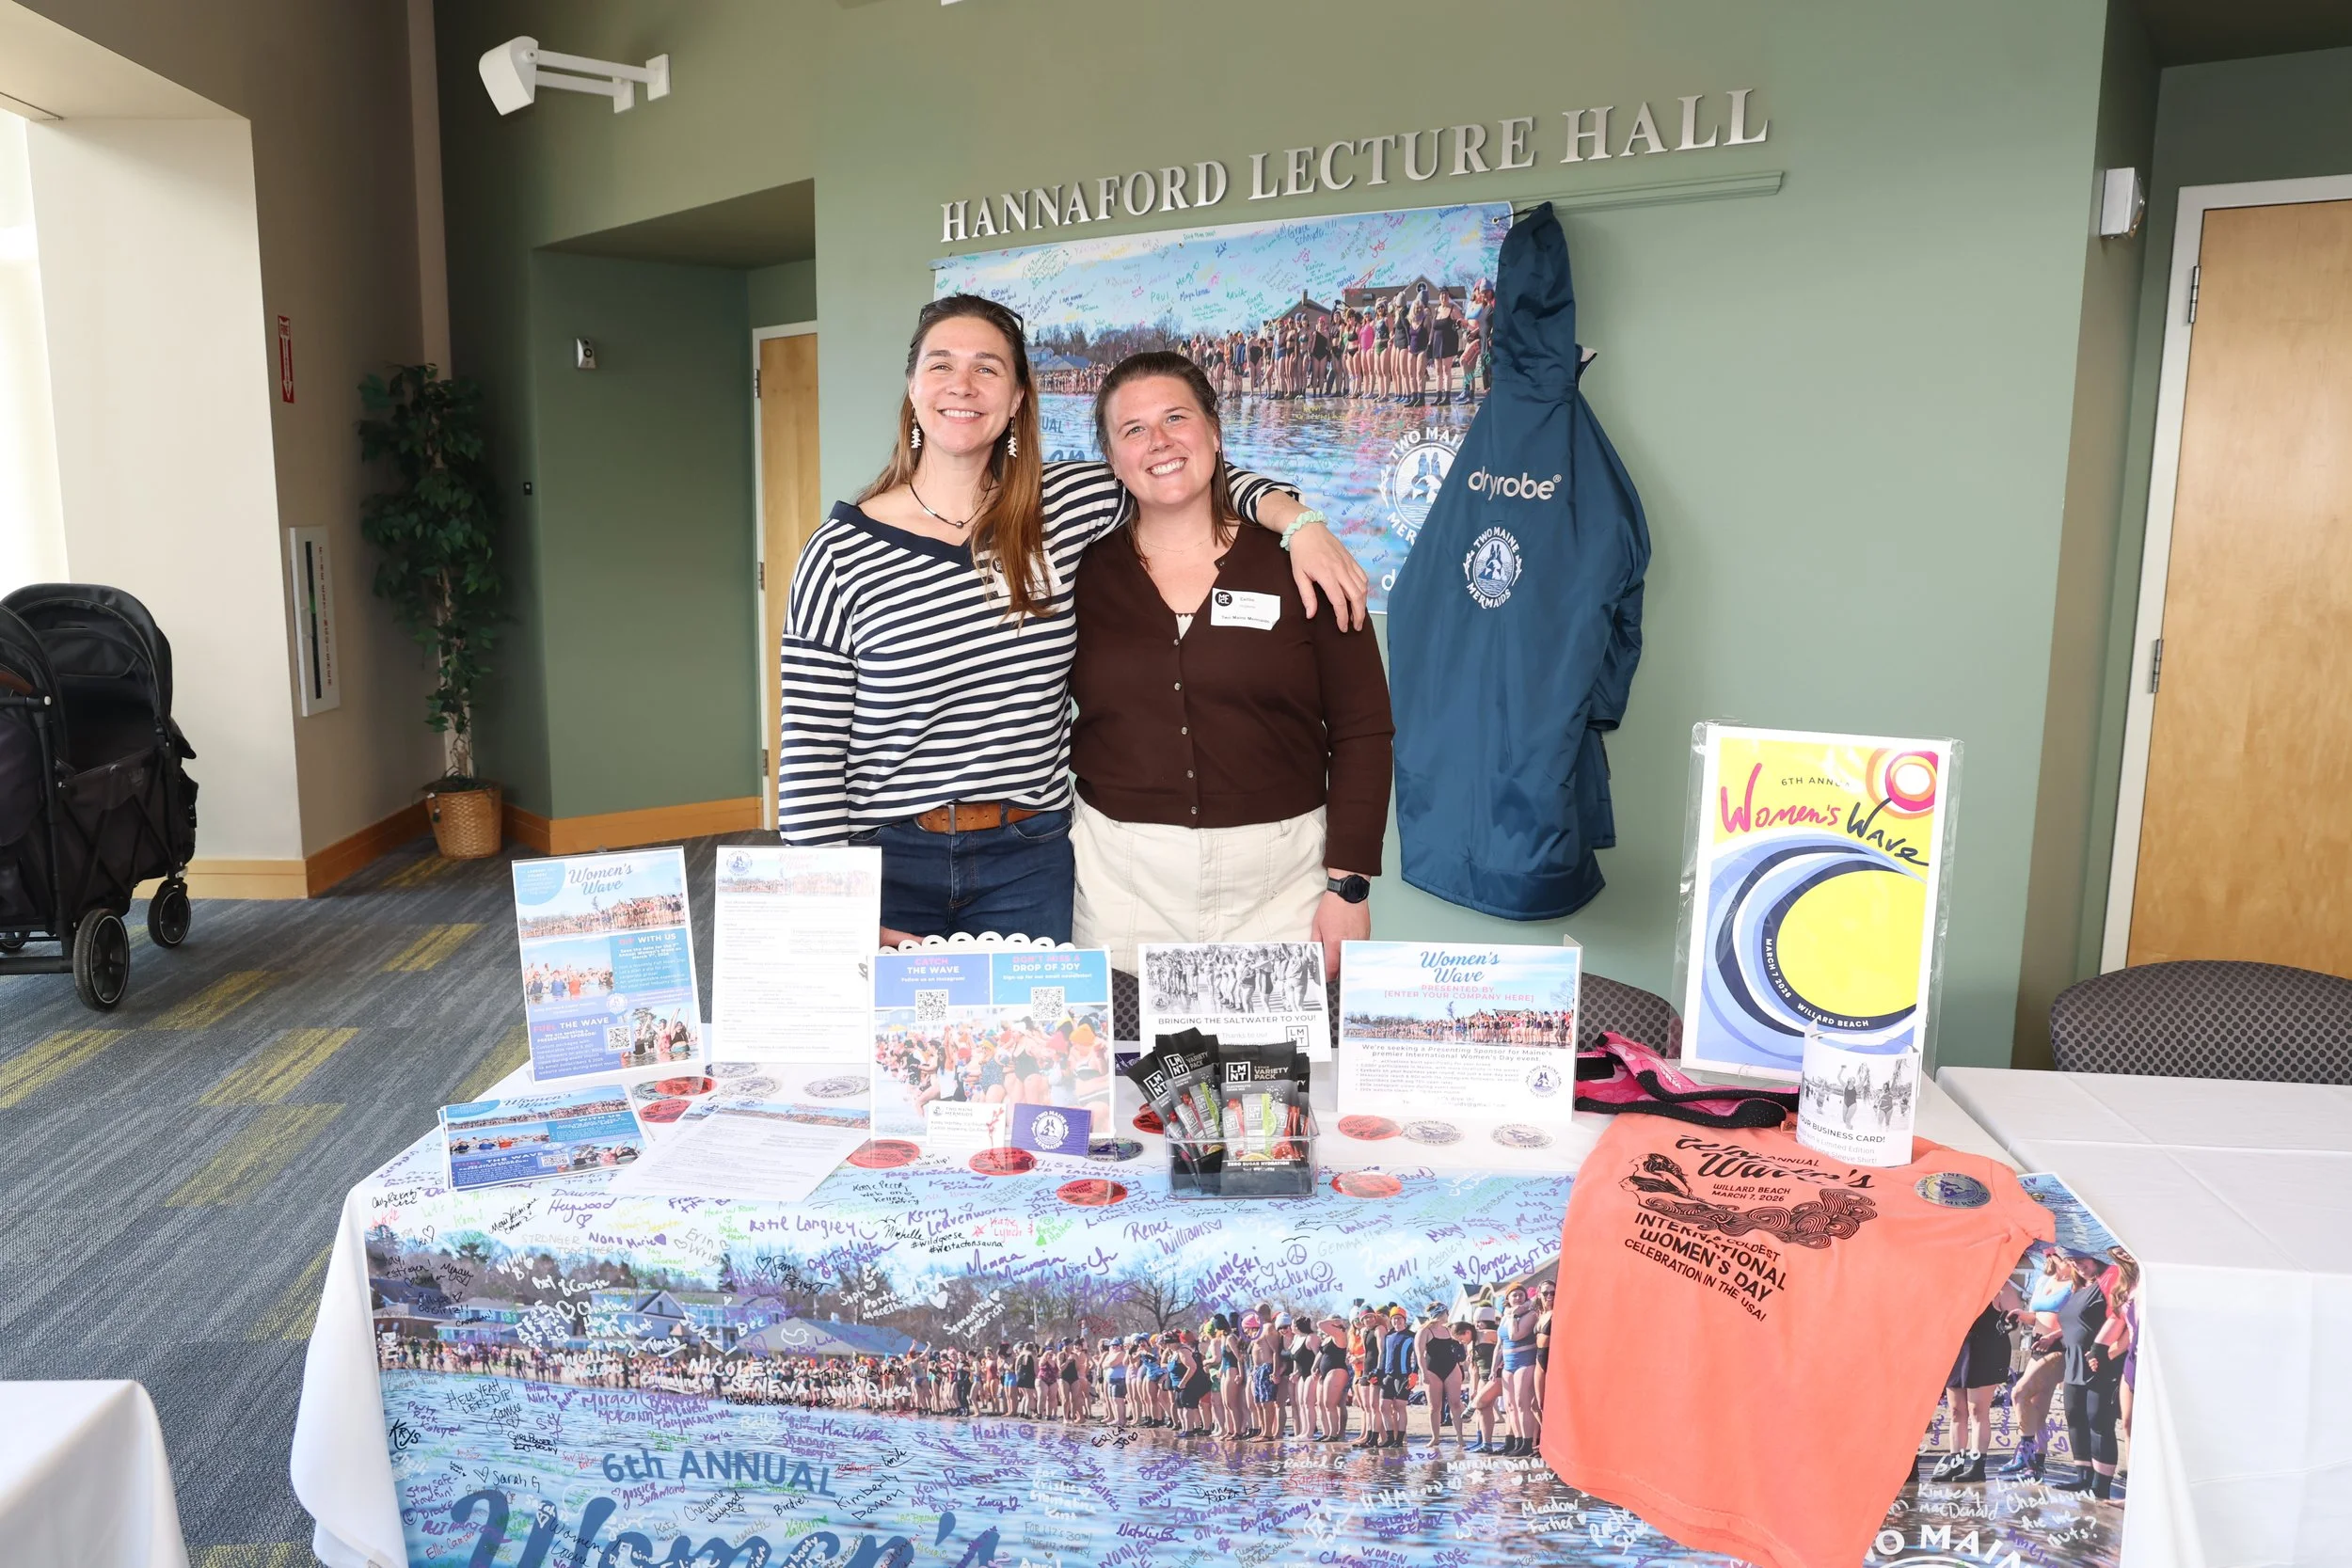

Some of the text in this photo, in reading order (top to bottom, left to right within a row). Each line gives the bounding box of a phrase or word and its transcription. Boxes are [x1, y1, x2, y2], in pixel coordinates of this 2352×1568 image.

[941, 87, 1771, 243] HANNAFORD LECTURE HALL
[1389, 430, 1421, 460] TWO
[1473, 526, 1520, 554] TWO MAINE
[1467, 582, 1512, 609] MERMAIDS
[1781, 777, 1804, 786] 6TH
[1721, 763, 1930, 866] Women's Wave
[568, 863, 633, 884] Women's
[581, 879, 623, 895] Wave
[638, 935, 661, 943] WITH
[1012, 962, 1080, 972] DROP OF JOY
[1421, 951, 1500, 968] Women's
[1434, 968, 1484, 984] Wave
[1765, 938, 1776, 970] MARCH
[1774, 978, 1791, 998] 2026
[1385, 990, 1420, 999] [ENTER
[1453, 992, 1501, 1001] COMPANY
[1504, 994, 1534, 1003] HERE]
[1797, 1003, 1835, 1024] WILLARD
[560, 1017, 610, 1029] THE WAVE
[1388, 1045, 1419, 1053] seeking
[1428, 1046, 1471, 1054] Presenting
[1168, 1054, 1183, 1066] LM
[1185, 1052, 1209, 1064] VARIETY
[1189, 1060, 1204, 1069] PACK
[1172, 1064, 1185, 1075] NT
[1230, 1065, 1248, 1073] LM
[503, 1093, 571, 1106] Women's
[1036, 1110, 1067, 1125] TWO MAINE
[1812, 1123, 1885, 1143] BUSINESS CARD!
[1034, 1137, 1064, 1150] MERMAIDS
[1849, 1146, 1875, 1154] Edition
[1766, 1155, 1820, 1167] ANNUAL
[1711, 1190, 1748, 1200] MARCH
[1758, 1194, 1785, 1202] 2026
[1712, 1183, 1791, 1195] WILLARD BEACH
[548, 1197, 617, 1223] Heywood
[907, 1208, 949, 1226] Kerry
[520, 1234, 580, 1244] STRONGER
[1726, 1238, 1781, 1262] COLDEST
[1640, 1228, 1773, 1303] WOMEN'S DAY
[1375, 1258, 1418, 1290] SAM!
[1624, 1238, 1767, 1322] CELEBRATION IN THE USA!
[688, 1354, 766, 1377] NICOLE
[446, 1379, 501, 1410] HELL YEAH
[493, 1472, 527, 1487] Sarah
[602, 1450, 836, 1497] 6th ANNUAL
[451, 1490, 1002, 1568] Women's
[1920, 1525, 2025, 1568] MAIN
